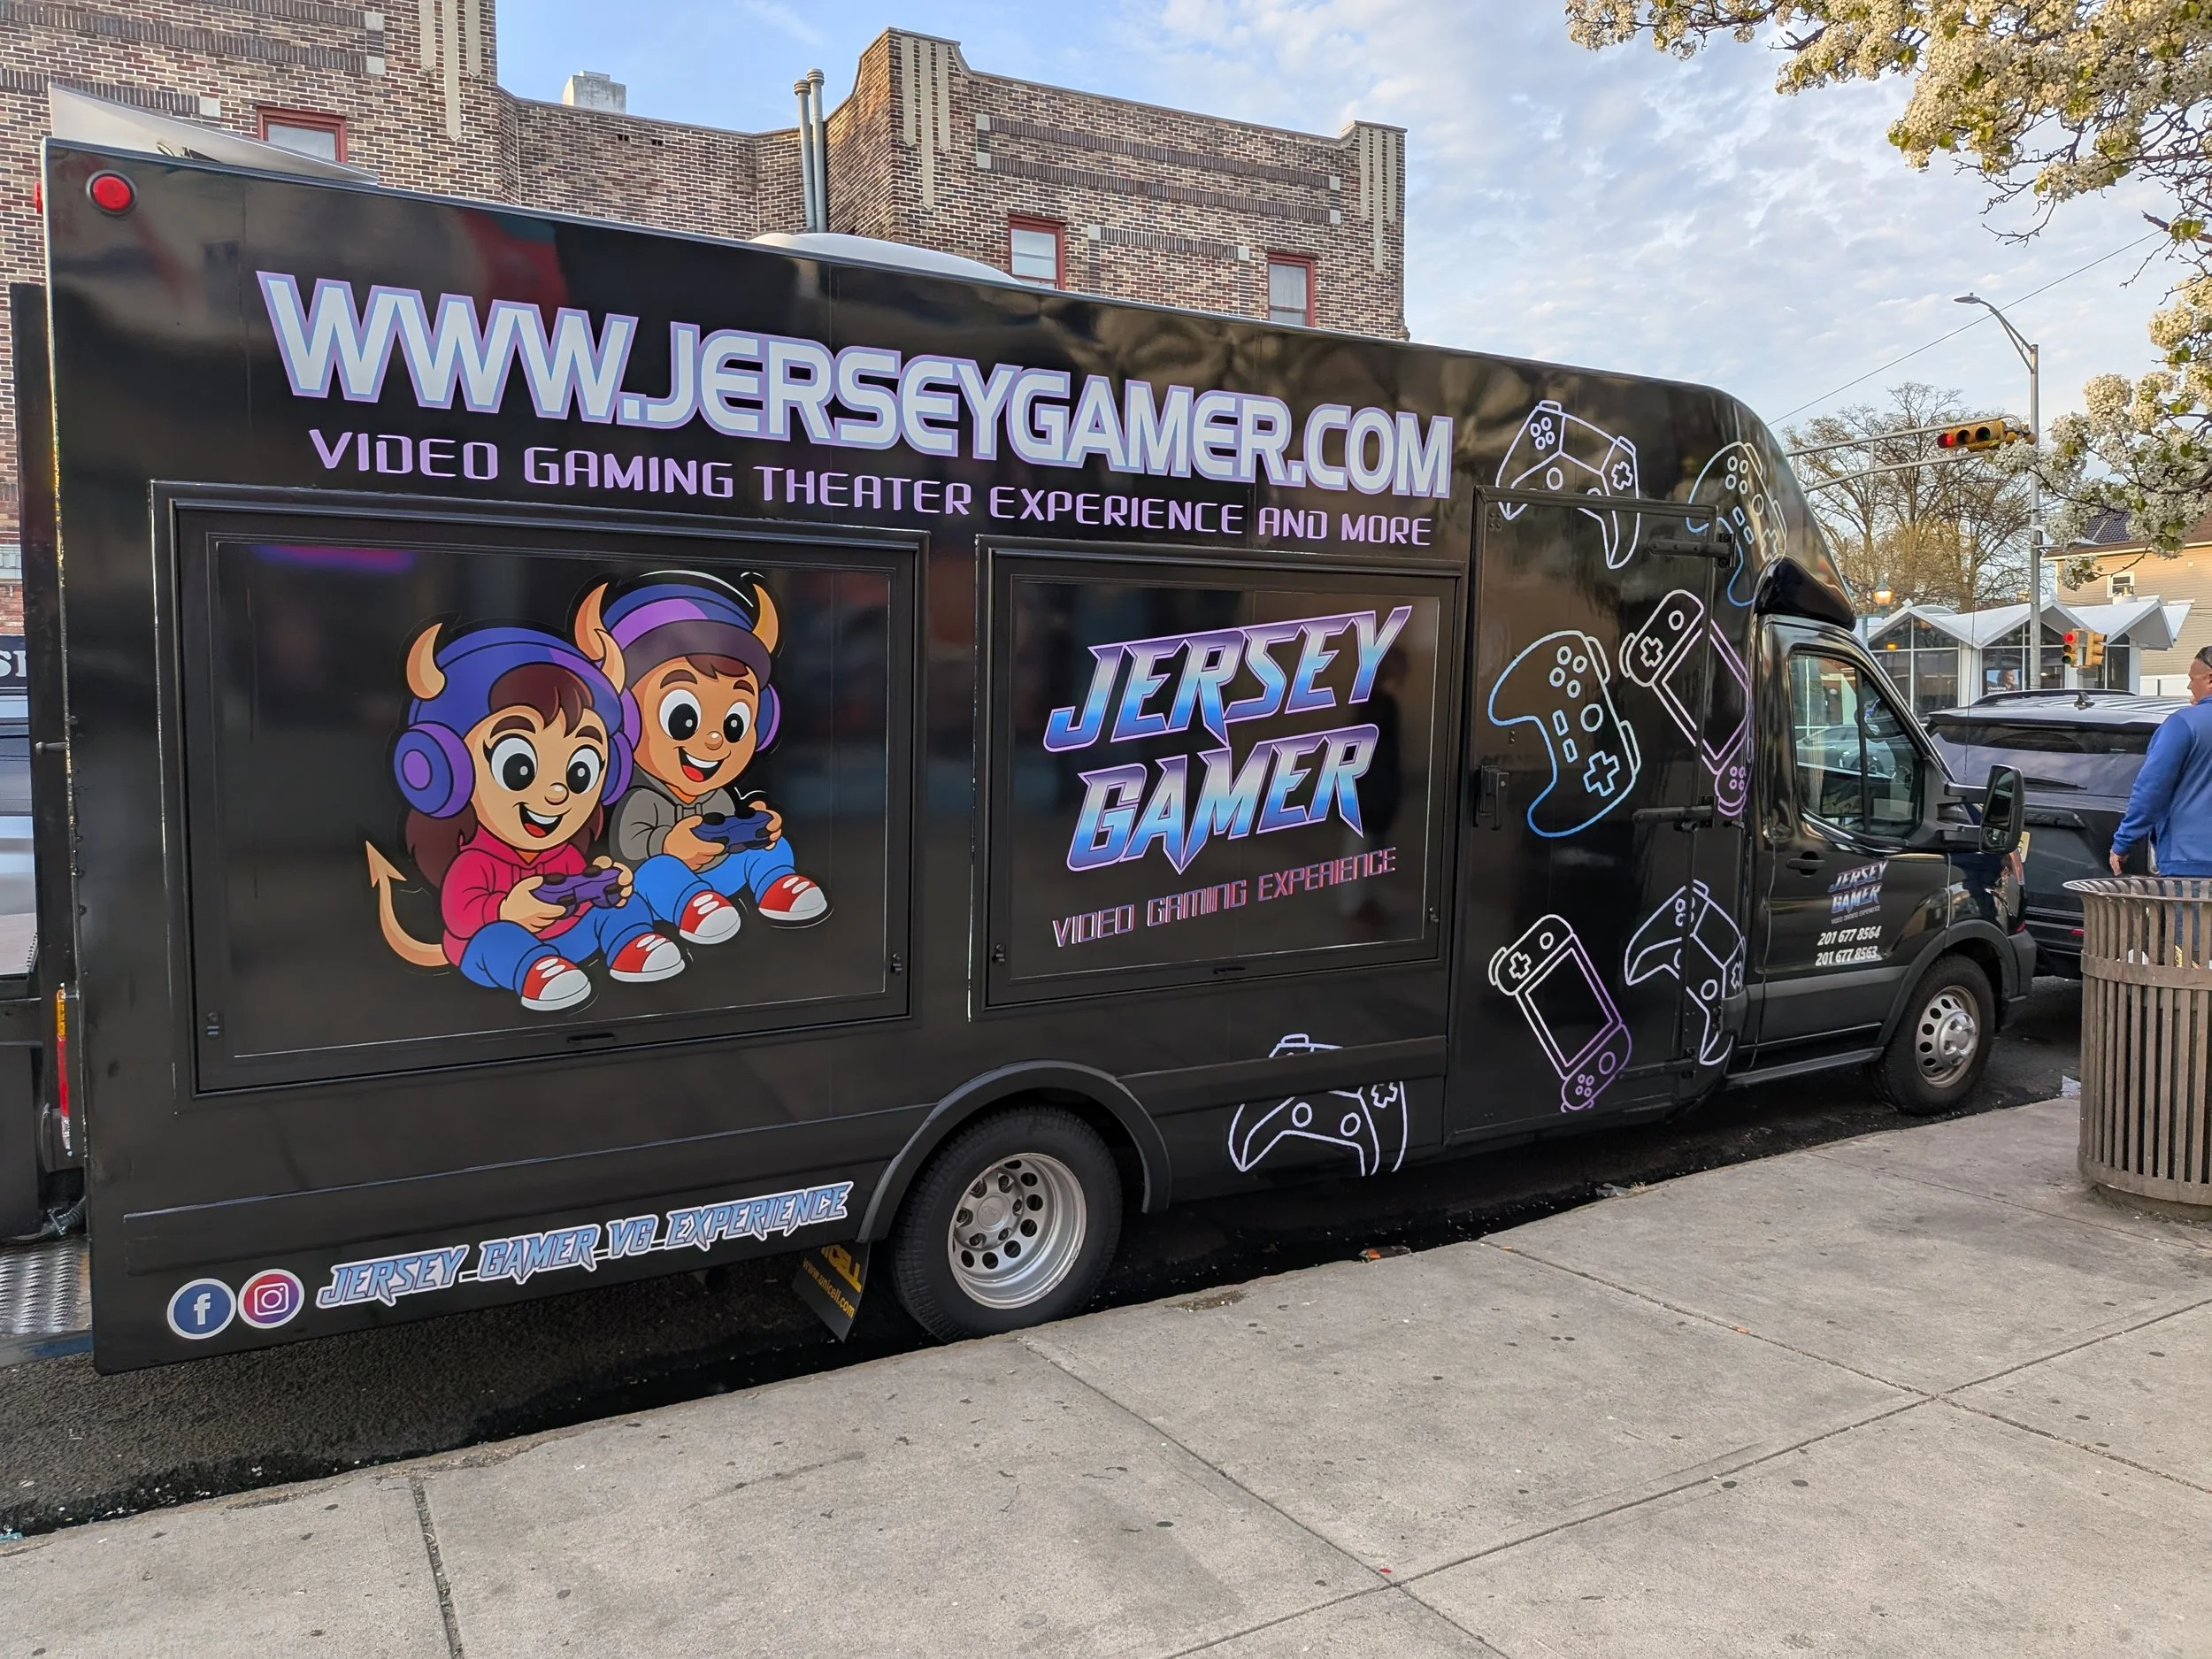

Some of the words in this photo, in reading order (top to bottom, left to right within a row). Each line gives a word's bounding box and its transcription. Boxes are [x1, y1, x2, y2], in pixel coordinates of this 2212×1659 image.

[256, 270, 1454, 498] WWW.JERSEYGAMER.COM
[308, 428, 499, 480] VIDEO
[524, 447, 733, 498] GAMING
[753, 465, 972, 516] THEATER
[989, 486, 1243, 534] EXPERIENCE
[1257, 507, 1327, 541] AND
[1340, 513, 1432, 546] MORE
[1043, 605, 1413, 753] JERSEY
[1066, 724, 1379, 875] GAMER
[1052, 903, 1135, 948] VIDEO
[1147, 879, 1247, 928] GAMING
[1257, 847, 1396, 902] EXPERIENCE
[1827, 859, 1889, 893] JERSEY
[1832, 883, 1882, 914] GAMER
[1815, 950, 1833, 966] 201
[1835, 949, 1855, 964] 677
[1855, 946, 1878, 961] 8563
[1816, 931, 1836, 946] 201
[1838, 928, 1857, 943] 677
[1857, 926, 1882, 940] 8564
[803, 1257, 855, 1318] www.unicell.com
